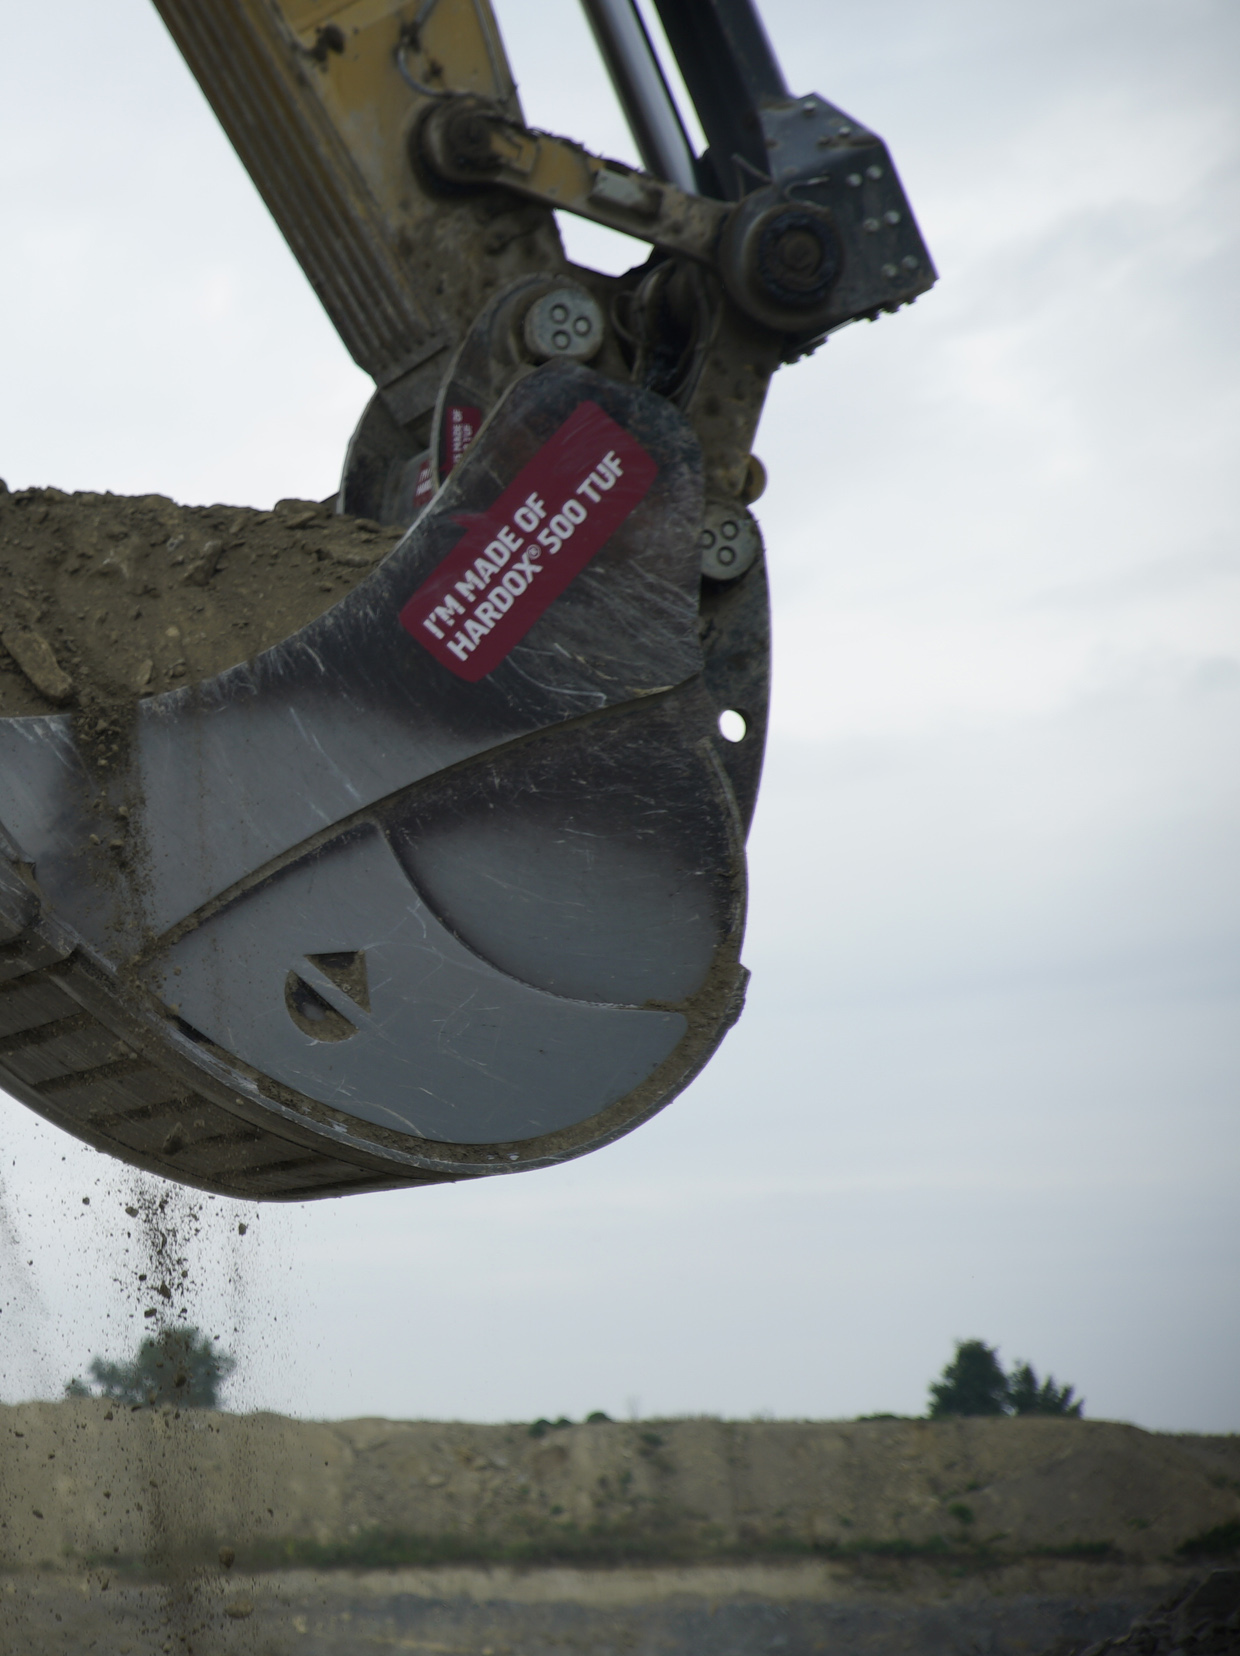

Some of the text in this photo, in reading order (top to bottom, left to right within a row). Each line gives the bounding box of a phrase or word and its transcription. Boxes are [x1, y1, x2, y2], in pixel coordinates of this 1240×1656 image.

[538, 499, 588, 555] 500
[576, 450, 623, 503] TUF
[423, 492, 547, 640] I'M MADE OF
